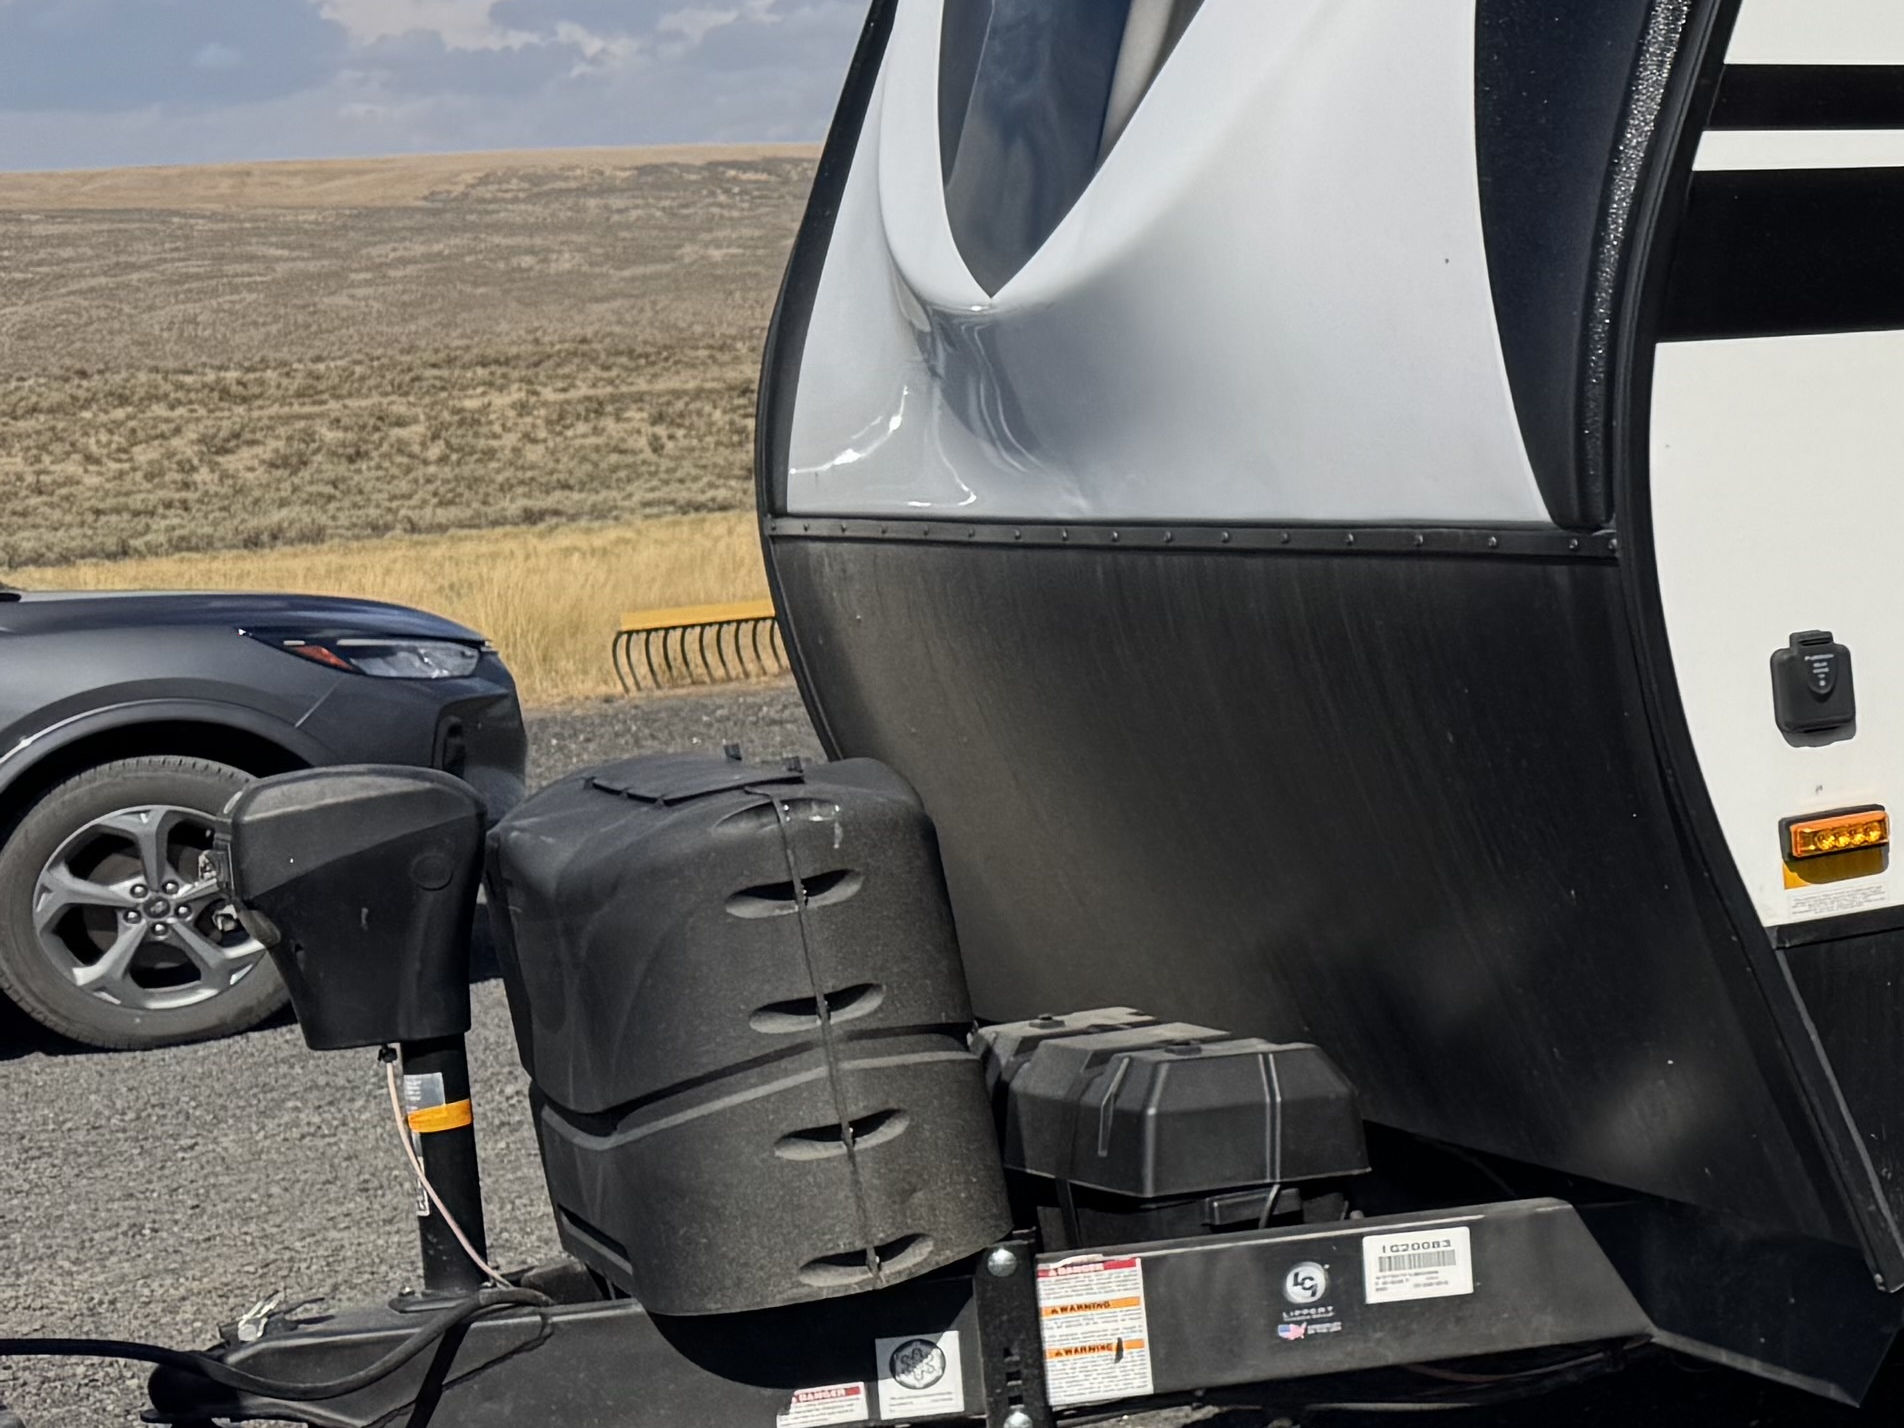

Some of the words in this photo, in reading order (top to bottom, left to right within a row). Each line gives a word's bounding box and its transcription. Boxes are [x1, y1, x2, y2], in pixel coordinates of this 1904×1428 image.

[1060, 1301, 1111, 1313] WARNING
[1065, 1343, 1113, 1355] WARNING
[798, 1388, 846, 1402] DANGER
